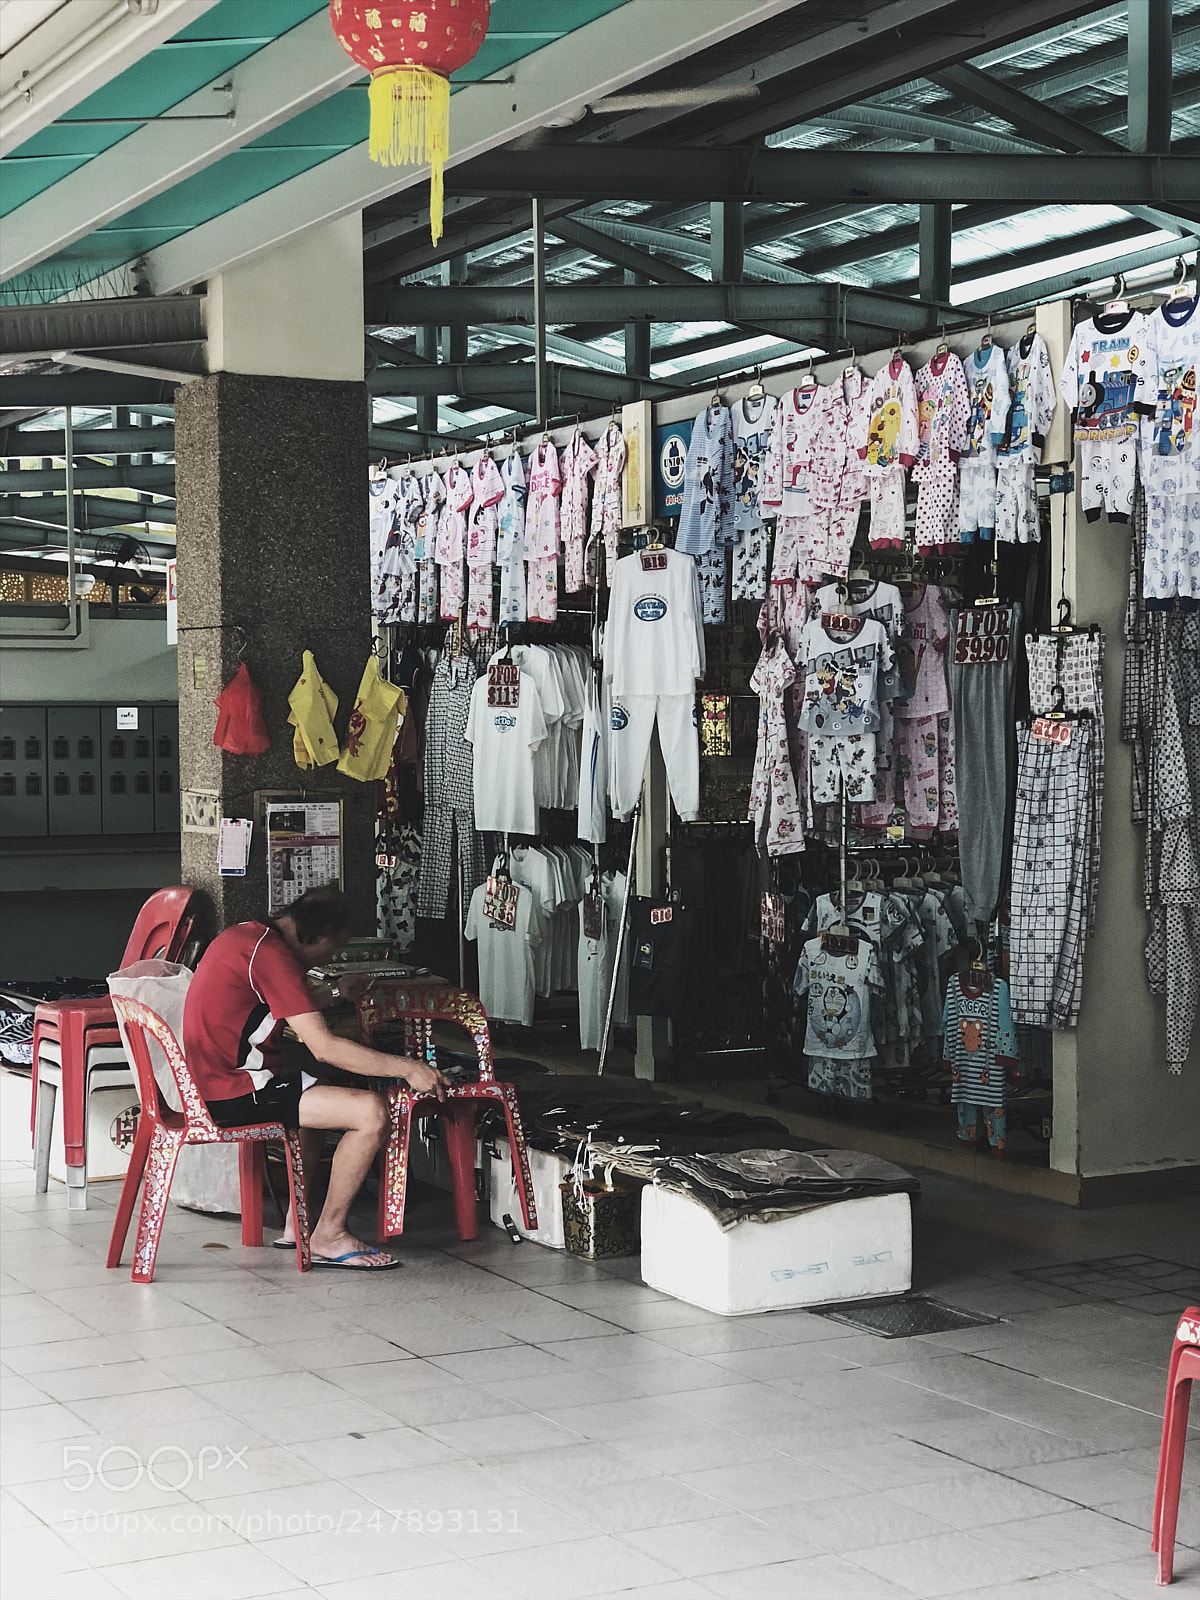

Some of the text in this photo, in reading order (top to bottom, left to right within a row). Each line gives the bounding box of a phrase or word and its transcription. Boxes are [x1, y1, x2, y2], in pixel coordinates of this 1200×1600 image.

[1092, 338, 1131, 354] TRAIN
[664, 456, 685, 468] UNION
[116, 1117, 138, 1146] H
